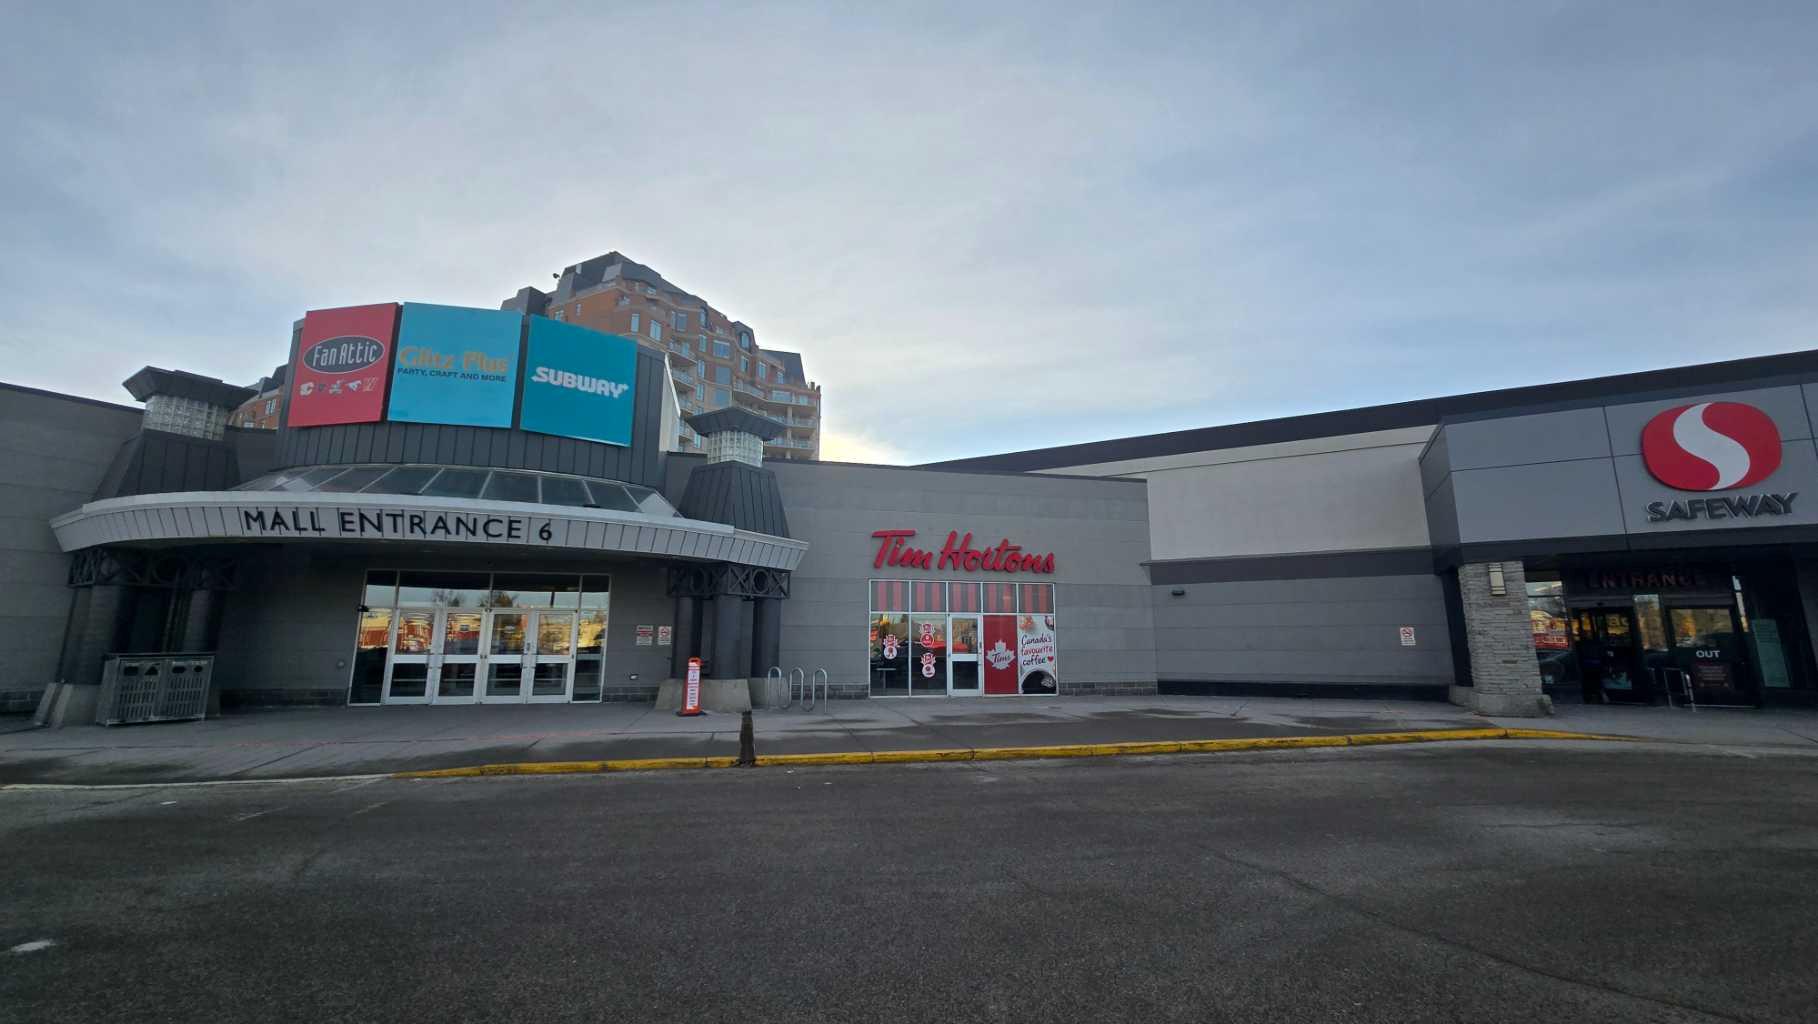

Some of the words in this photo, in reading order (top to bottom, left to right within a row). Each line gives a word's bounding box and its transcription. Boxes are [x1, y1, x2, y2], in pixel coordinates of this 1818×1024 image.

[312, 344, 337, 367] Fan
[339, 341, 377, 365] Attic
[399, 345, 454, 369] Glitz
[463, 351, 508, 372] Plus
[429, 369, 459, 379] CRAFT
[460, 372, 480, 381] AND
[481, 374, 507, 382] MORE
[531, 366, 629, 399] SUBWAY
[1647, 493, 1798, 522] SAFEWAY
[243, 509, 326, 533] MALL
[340, 511, 522, 540] ENTRANCE
[538, 521, 553, 542] 6
[871, 529, 933, 570] Tim
[937, 530, 1056, 573] Hortons
[1021, 633, 1052, 646] Canada's
[1021, 645, 1053, 657] favourite
[1022, 654, 1046, 666] coffee
[1695, 649, 1721, 658] OUT
